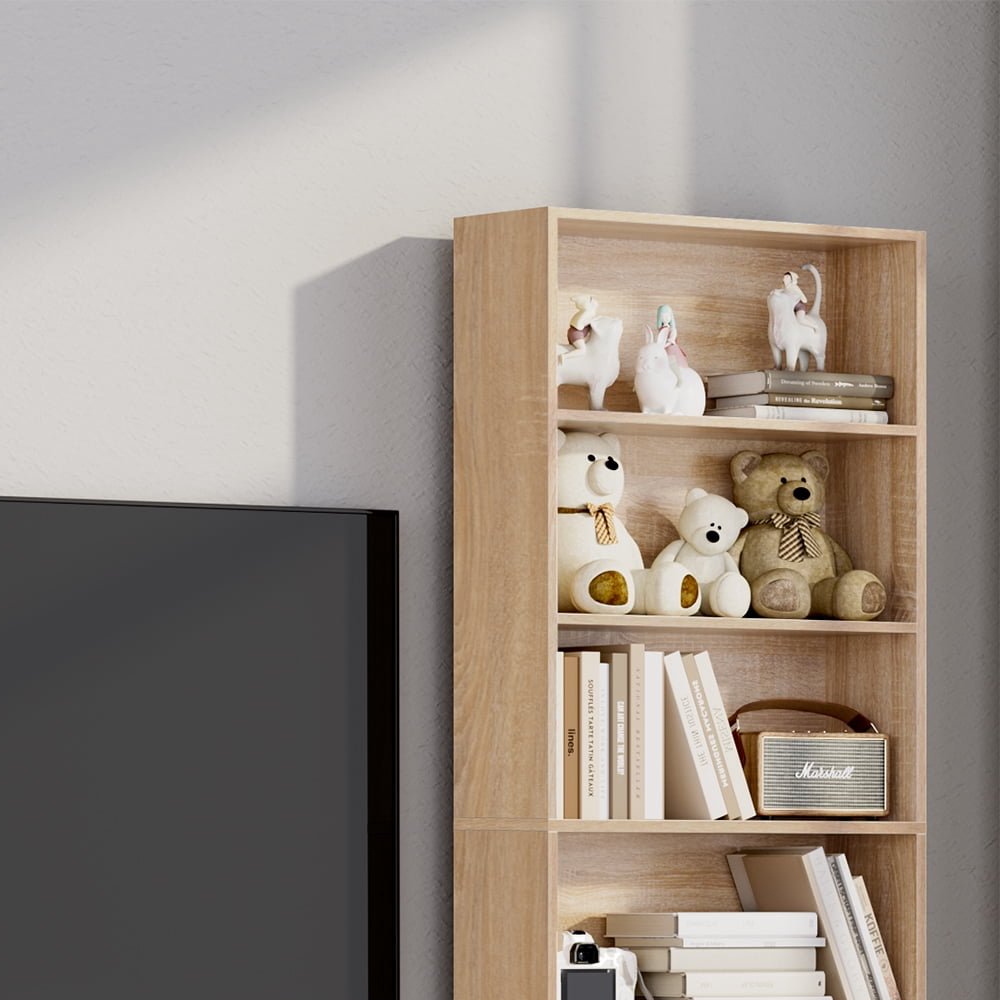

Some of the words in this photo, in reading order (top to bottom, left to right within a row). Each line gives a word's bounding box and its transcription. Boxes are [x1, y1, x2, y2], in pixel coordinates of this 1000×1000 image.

[567, 729, 576, 757] lines.
[795, 762, 854, 779] Marshall
[864, 913, 885, 957] KOFFIE
